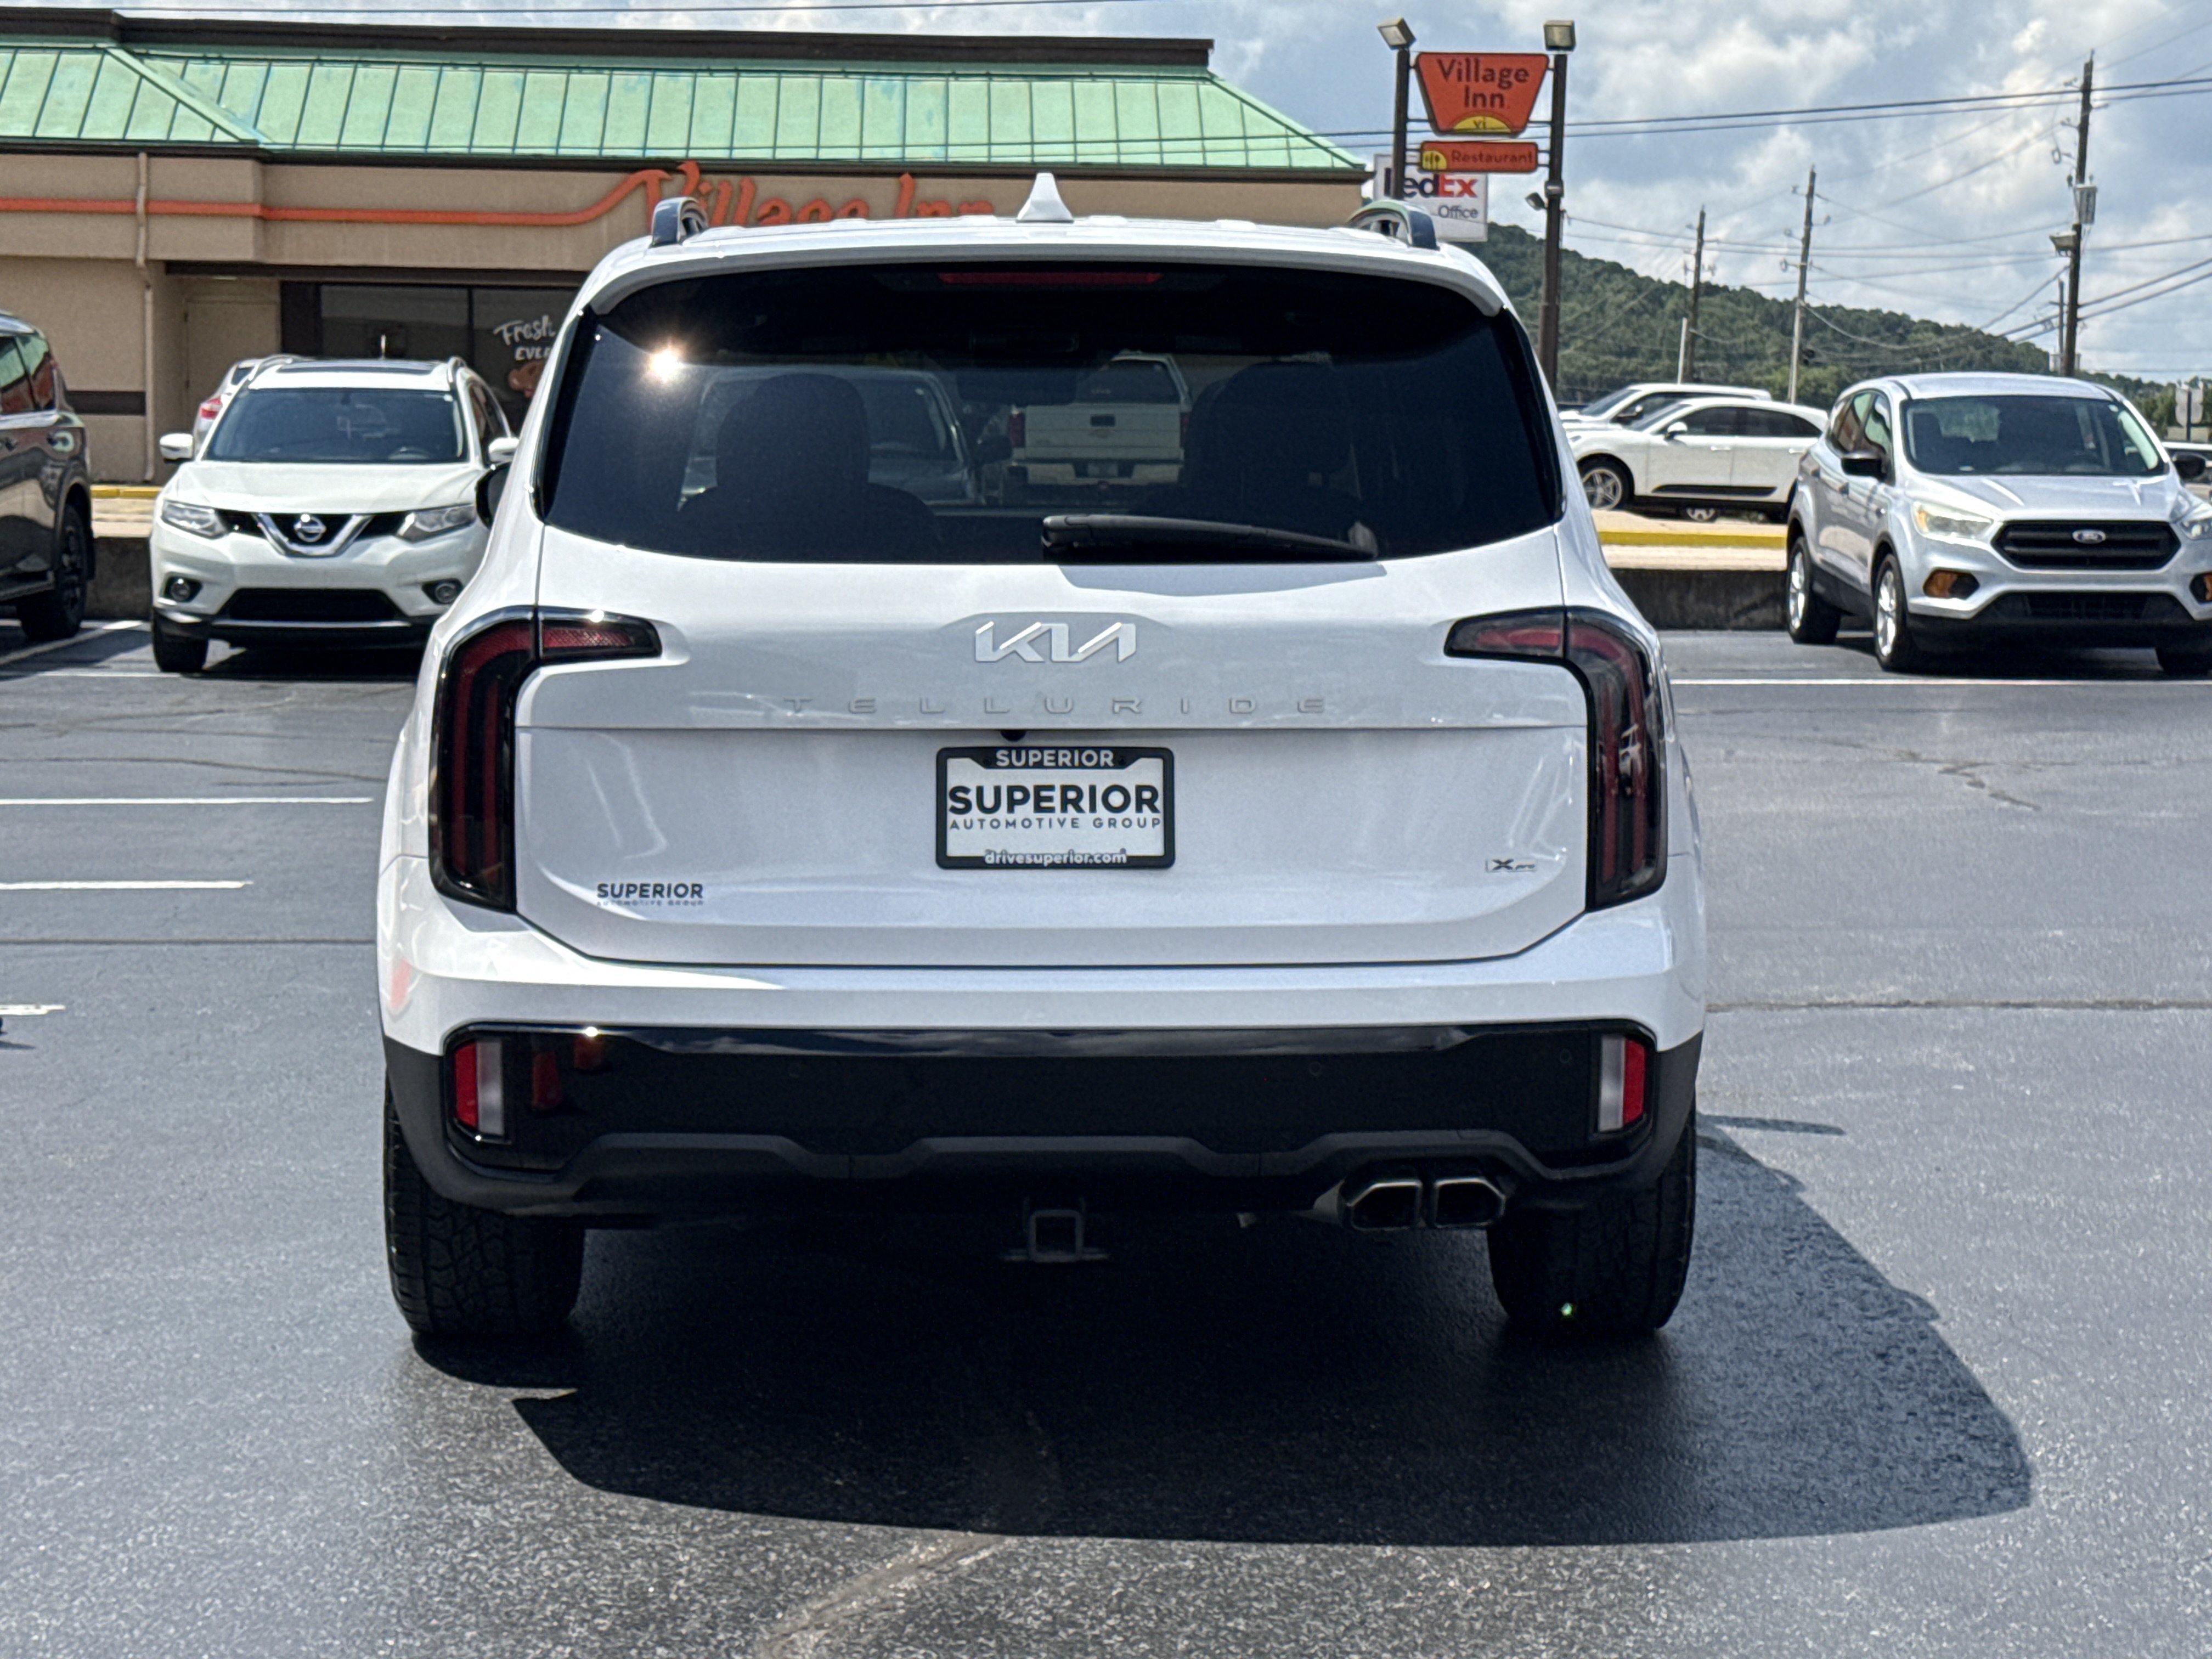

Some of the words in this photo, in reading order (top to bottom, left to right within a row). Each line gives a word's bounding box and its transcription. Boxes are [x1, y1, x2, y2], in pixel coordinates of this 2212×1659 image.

[1437, 57, 1530, 89] Village
[1464, 86, 1505, 108] Inn
[1451, 150, 1533, 163] Restaurant
[1438, 205, 1479, 219] Office
[974, 621, 1137, 663] KIA
[783, 696, 1327, 714] TELLURIDE
[996, 749, 1114, 767] SUPERIOR
[949, 785, 1161, 815] SUPERIOR
[950, 818, 1080, 830] AUTOMOTIVE
[1092, 817, 1161, 830] GROUP
[985, 851, 1127, 866] drivesuperior.com
[597, 883, 703, 899] SUPERIOR
